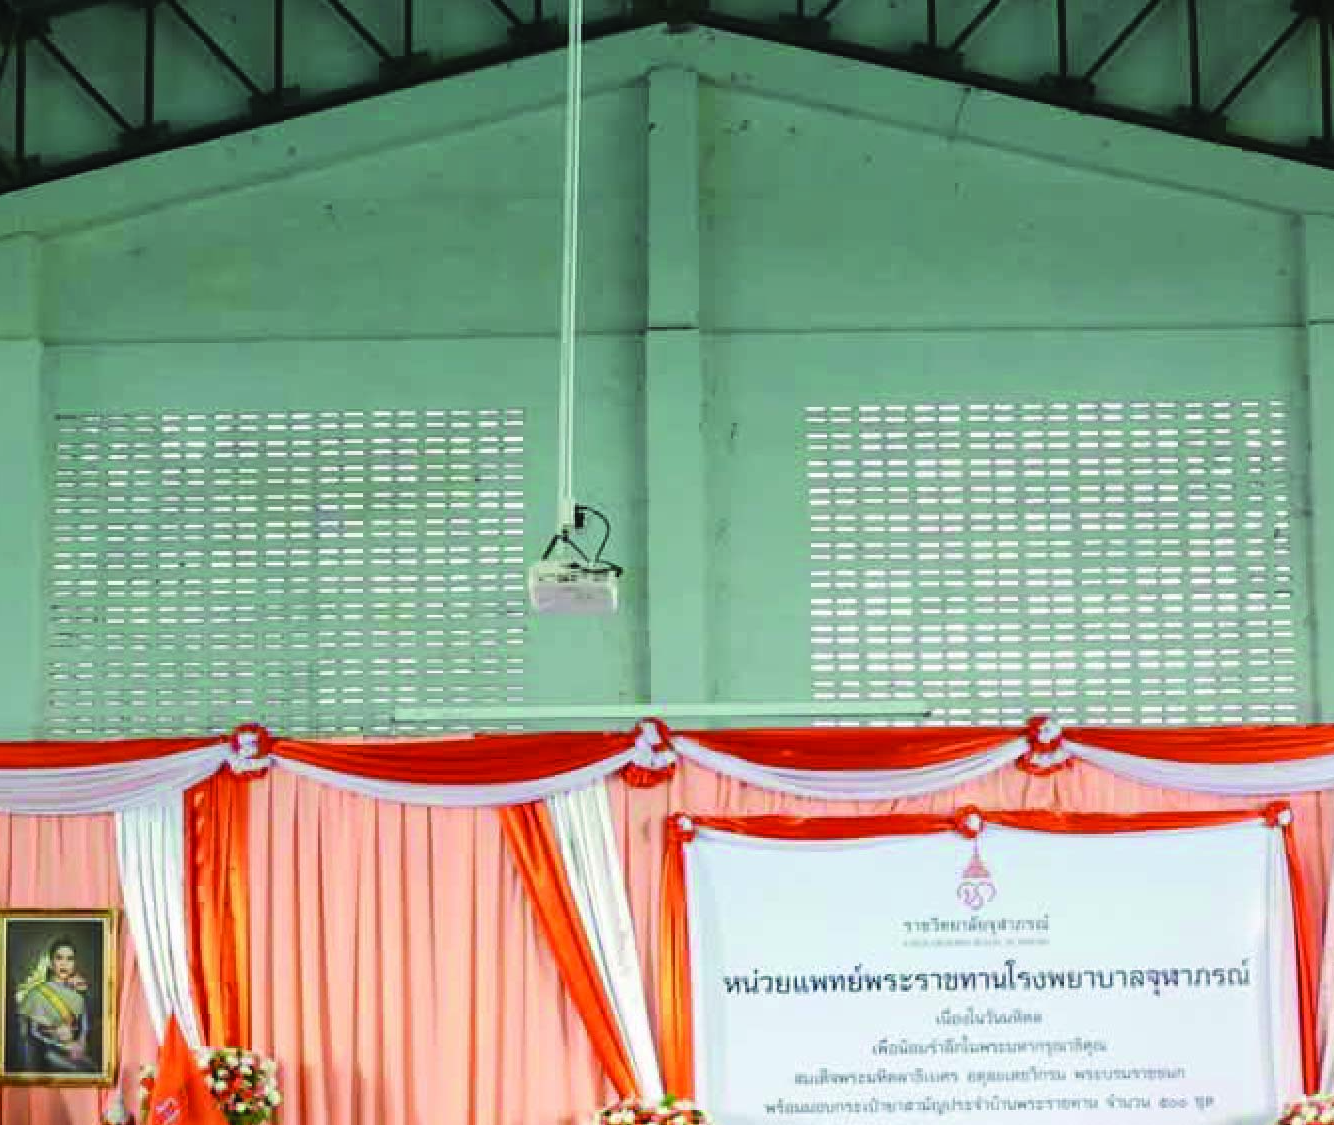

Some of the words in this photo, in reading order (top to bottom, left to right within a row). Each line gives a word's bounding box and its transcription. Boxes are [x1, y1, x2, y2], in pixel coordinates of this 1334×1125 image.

[723, 958, 1251, 996] หน่วยแพทย์พระราชทานโรงพยาบาลจุฬาภรณ์
